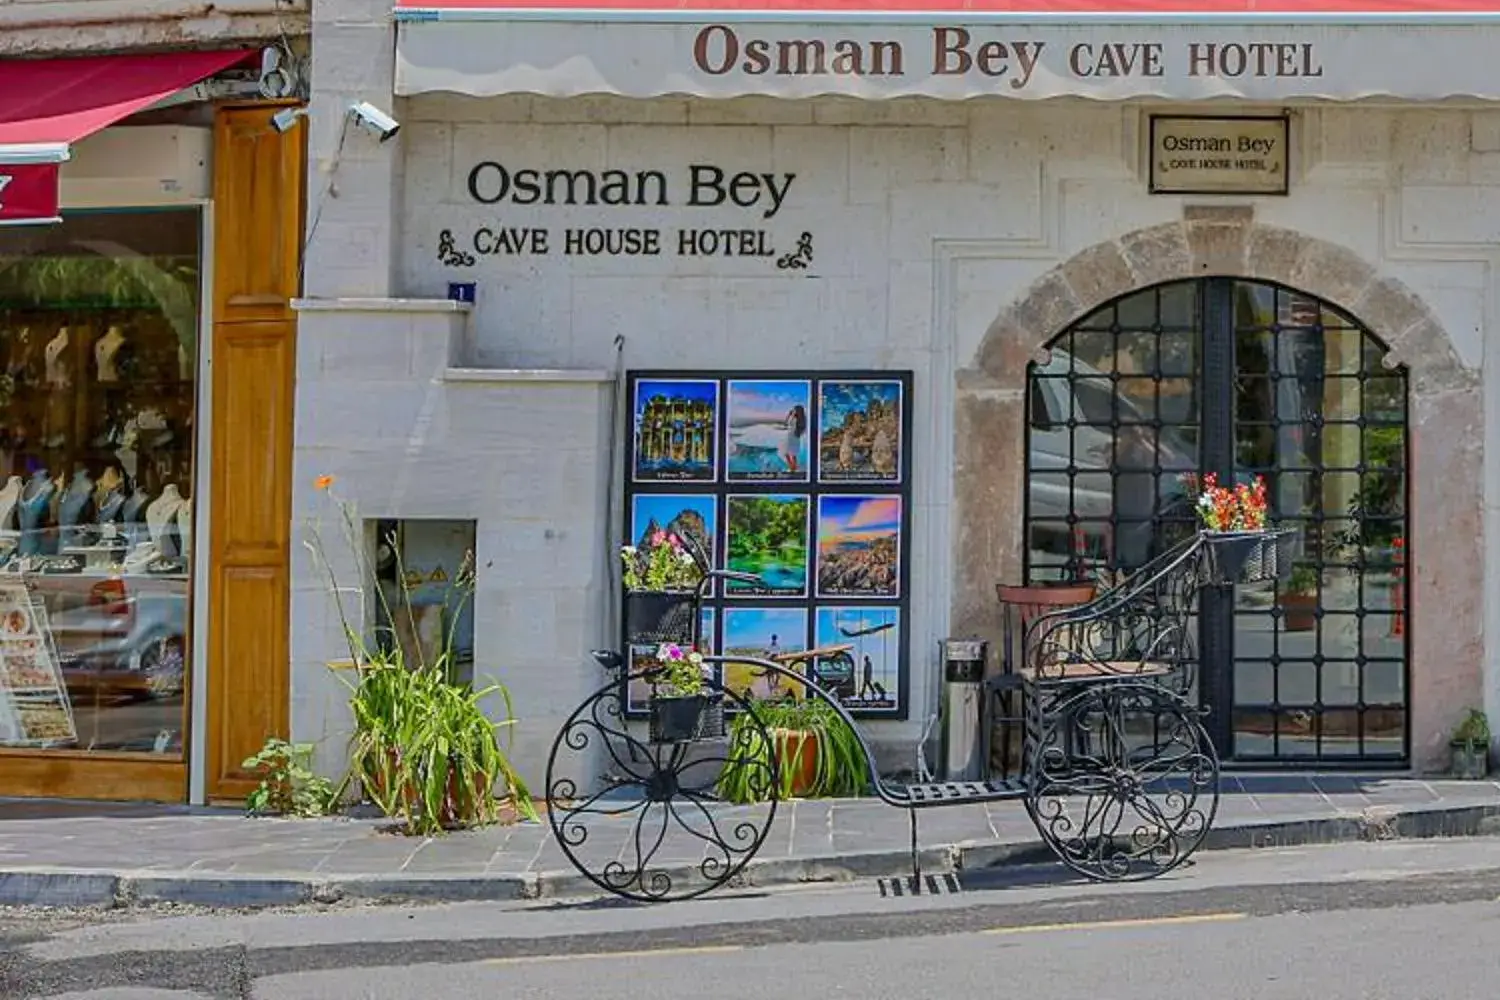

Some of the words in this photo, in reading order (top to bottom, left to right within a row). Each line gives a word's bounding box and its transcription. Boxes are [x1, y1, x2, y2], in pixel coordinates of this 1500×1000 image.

[693, 25, 905, 76] Osman
[931, 27, 1047, 89] Bey
[1069, 43, 1163, 78] CAVE
[1187, 42, 1324, 78] HOTEL
[1163, 135, 1231, 152] Osman
[1237, 136, 1276, 155] Bey
[466, 161, 670, 206] Osman
[686, 165, 797, 218] Bey
[473, 228, 549, 256] CAVE
[565, 228, 660, 256] HOUSE
[678, 229, 775, 258] HOTEL
